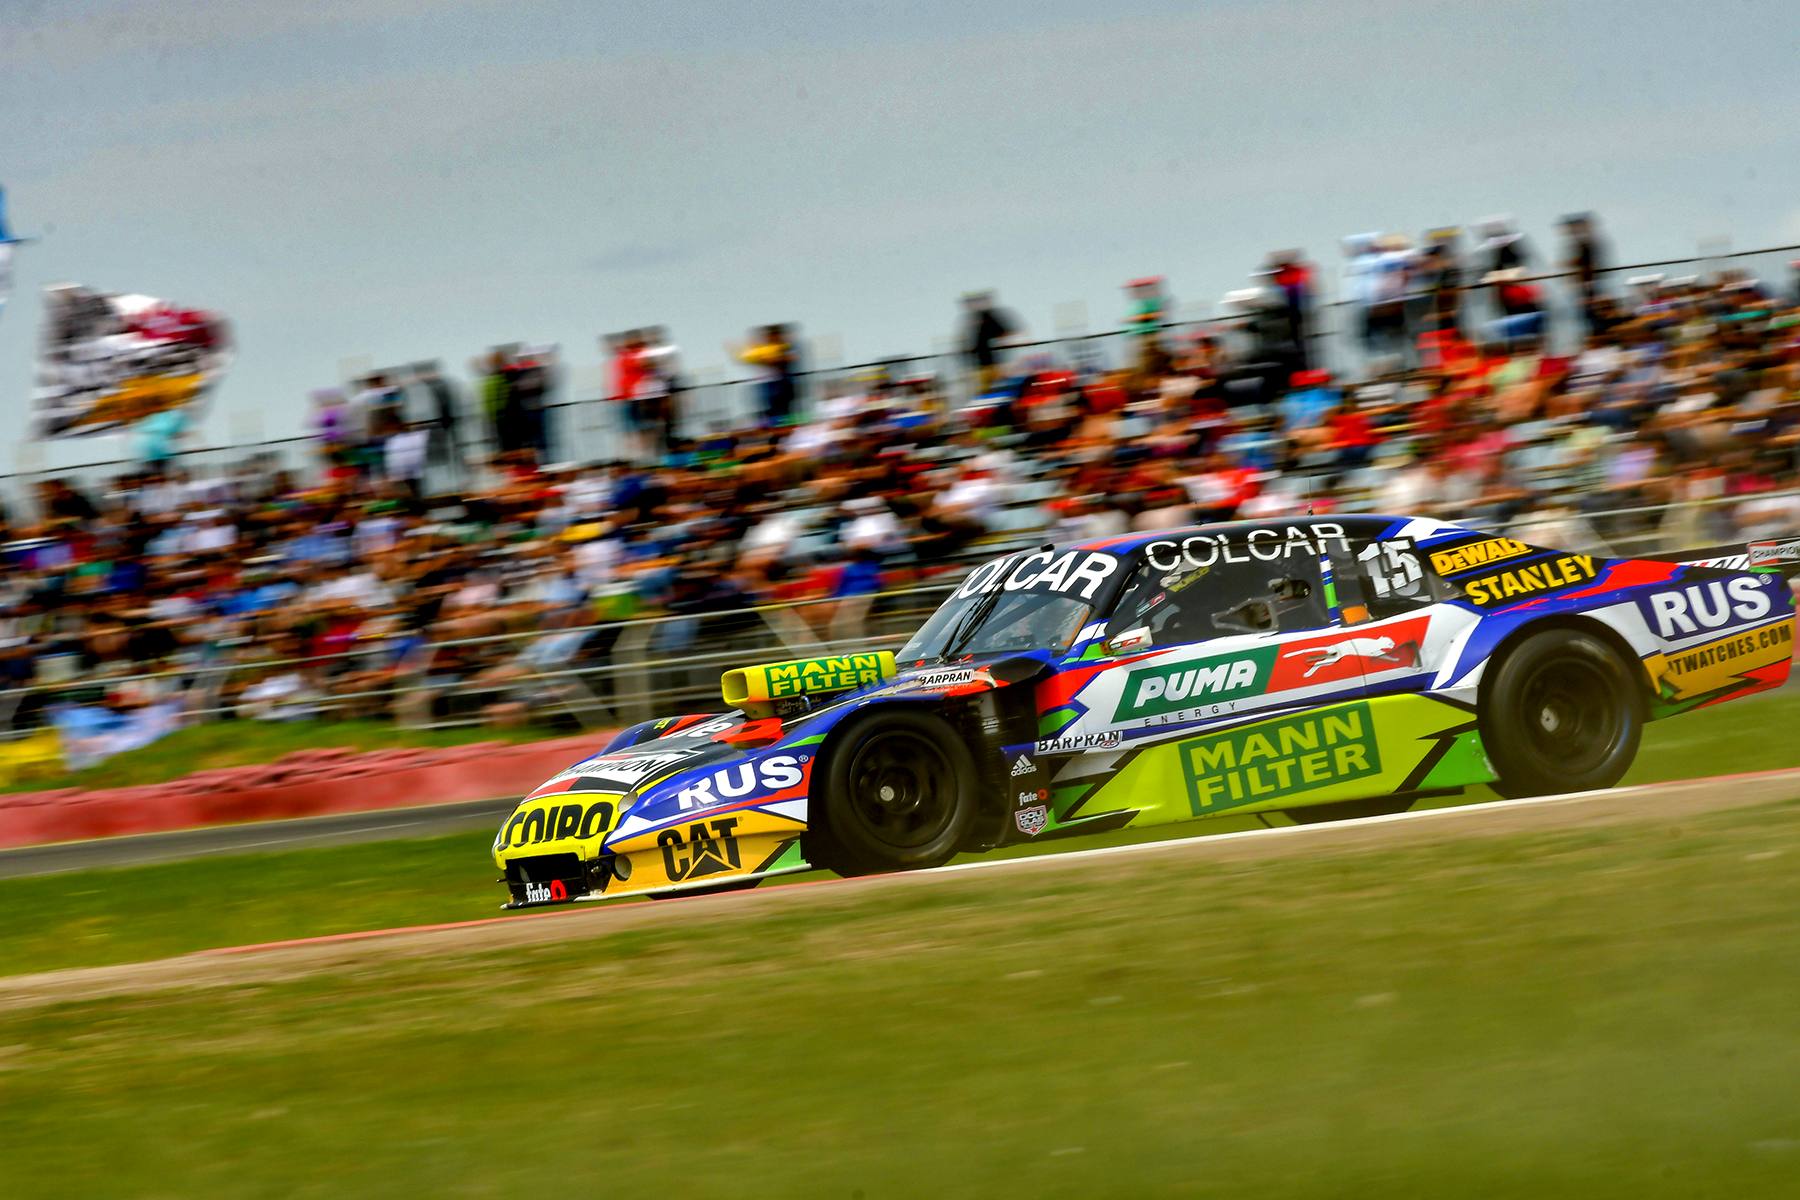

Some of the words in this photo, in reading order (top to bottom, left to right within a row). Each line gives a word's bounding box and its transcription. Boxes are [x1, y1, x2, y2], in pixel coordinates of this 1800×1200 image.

[1145, 523, 1352, 571] COLCAR
[1357, 540, 1423, 598] 15
[1465, 555, 1597, 606] STANLEY
[1650, 577, 1772, 638] RUS
[770, 655, 877, 682] MANN
[772, 670, 879, 696] FILTER
[1133, 659, 1258, 708] PUMA
[1144, 702, 1237, 728] ENERGY
[1038, 731, 1120, 752] BARPRAN
[1189, 710, 1365, 777] MANN
[678, 755, 803, 810] RUS
[1011, 765, 1037, 777] adidas
[1196, 744, 1373, 808] FILTER
[1019, 792, 1038, 806] fate
[657, 817, 742, 882] CAT
